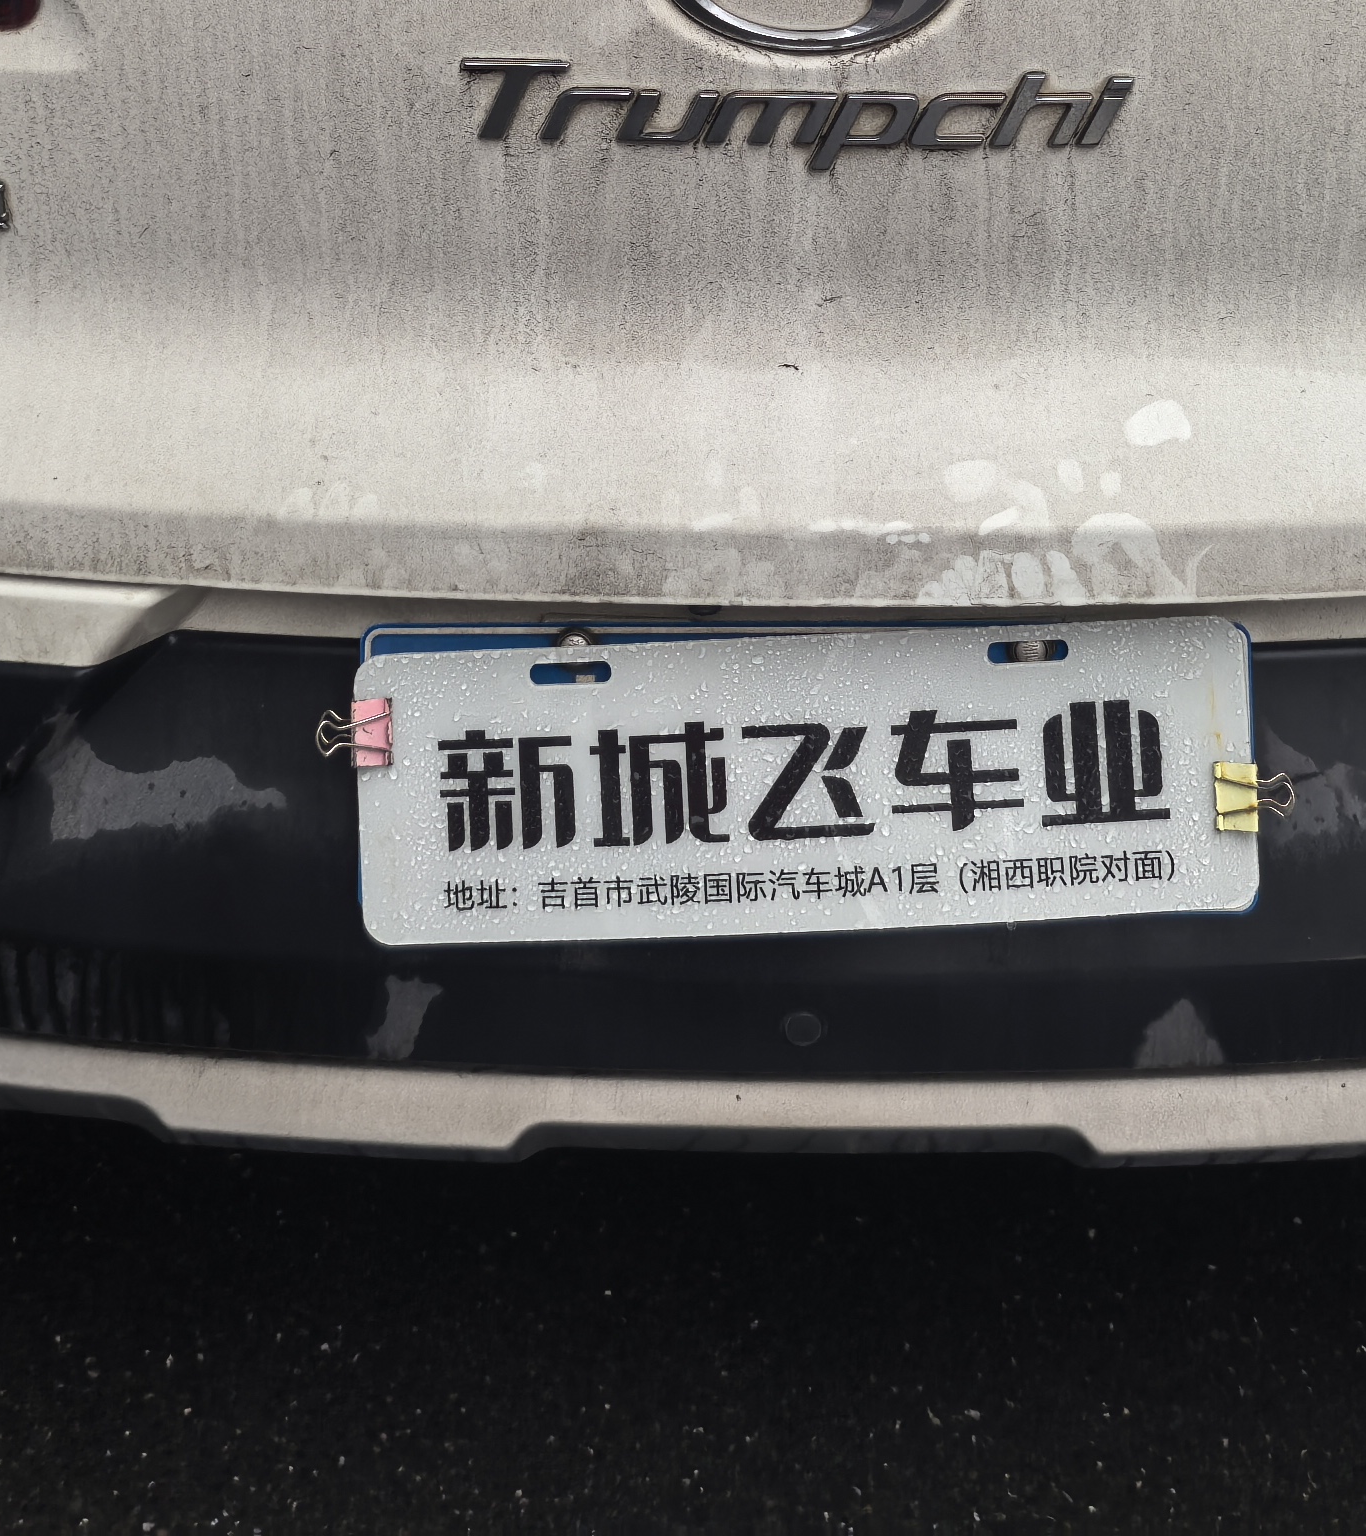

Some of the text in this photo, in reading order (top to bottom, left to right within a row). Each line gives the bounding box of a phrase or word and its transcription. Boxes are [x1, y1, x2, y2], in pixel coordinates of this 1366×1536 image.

[459, 58, 1135, 172] Trumpchi
[437, 698, 1172, 852] 新城飞车业
